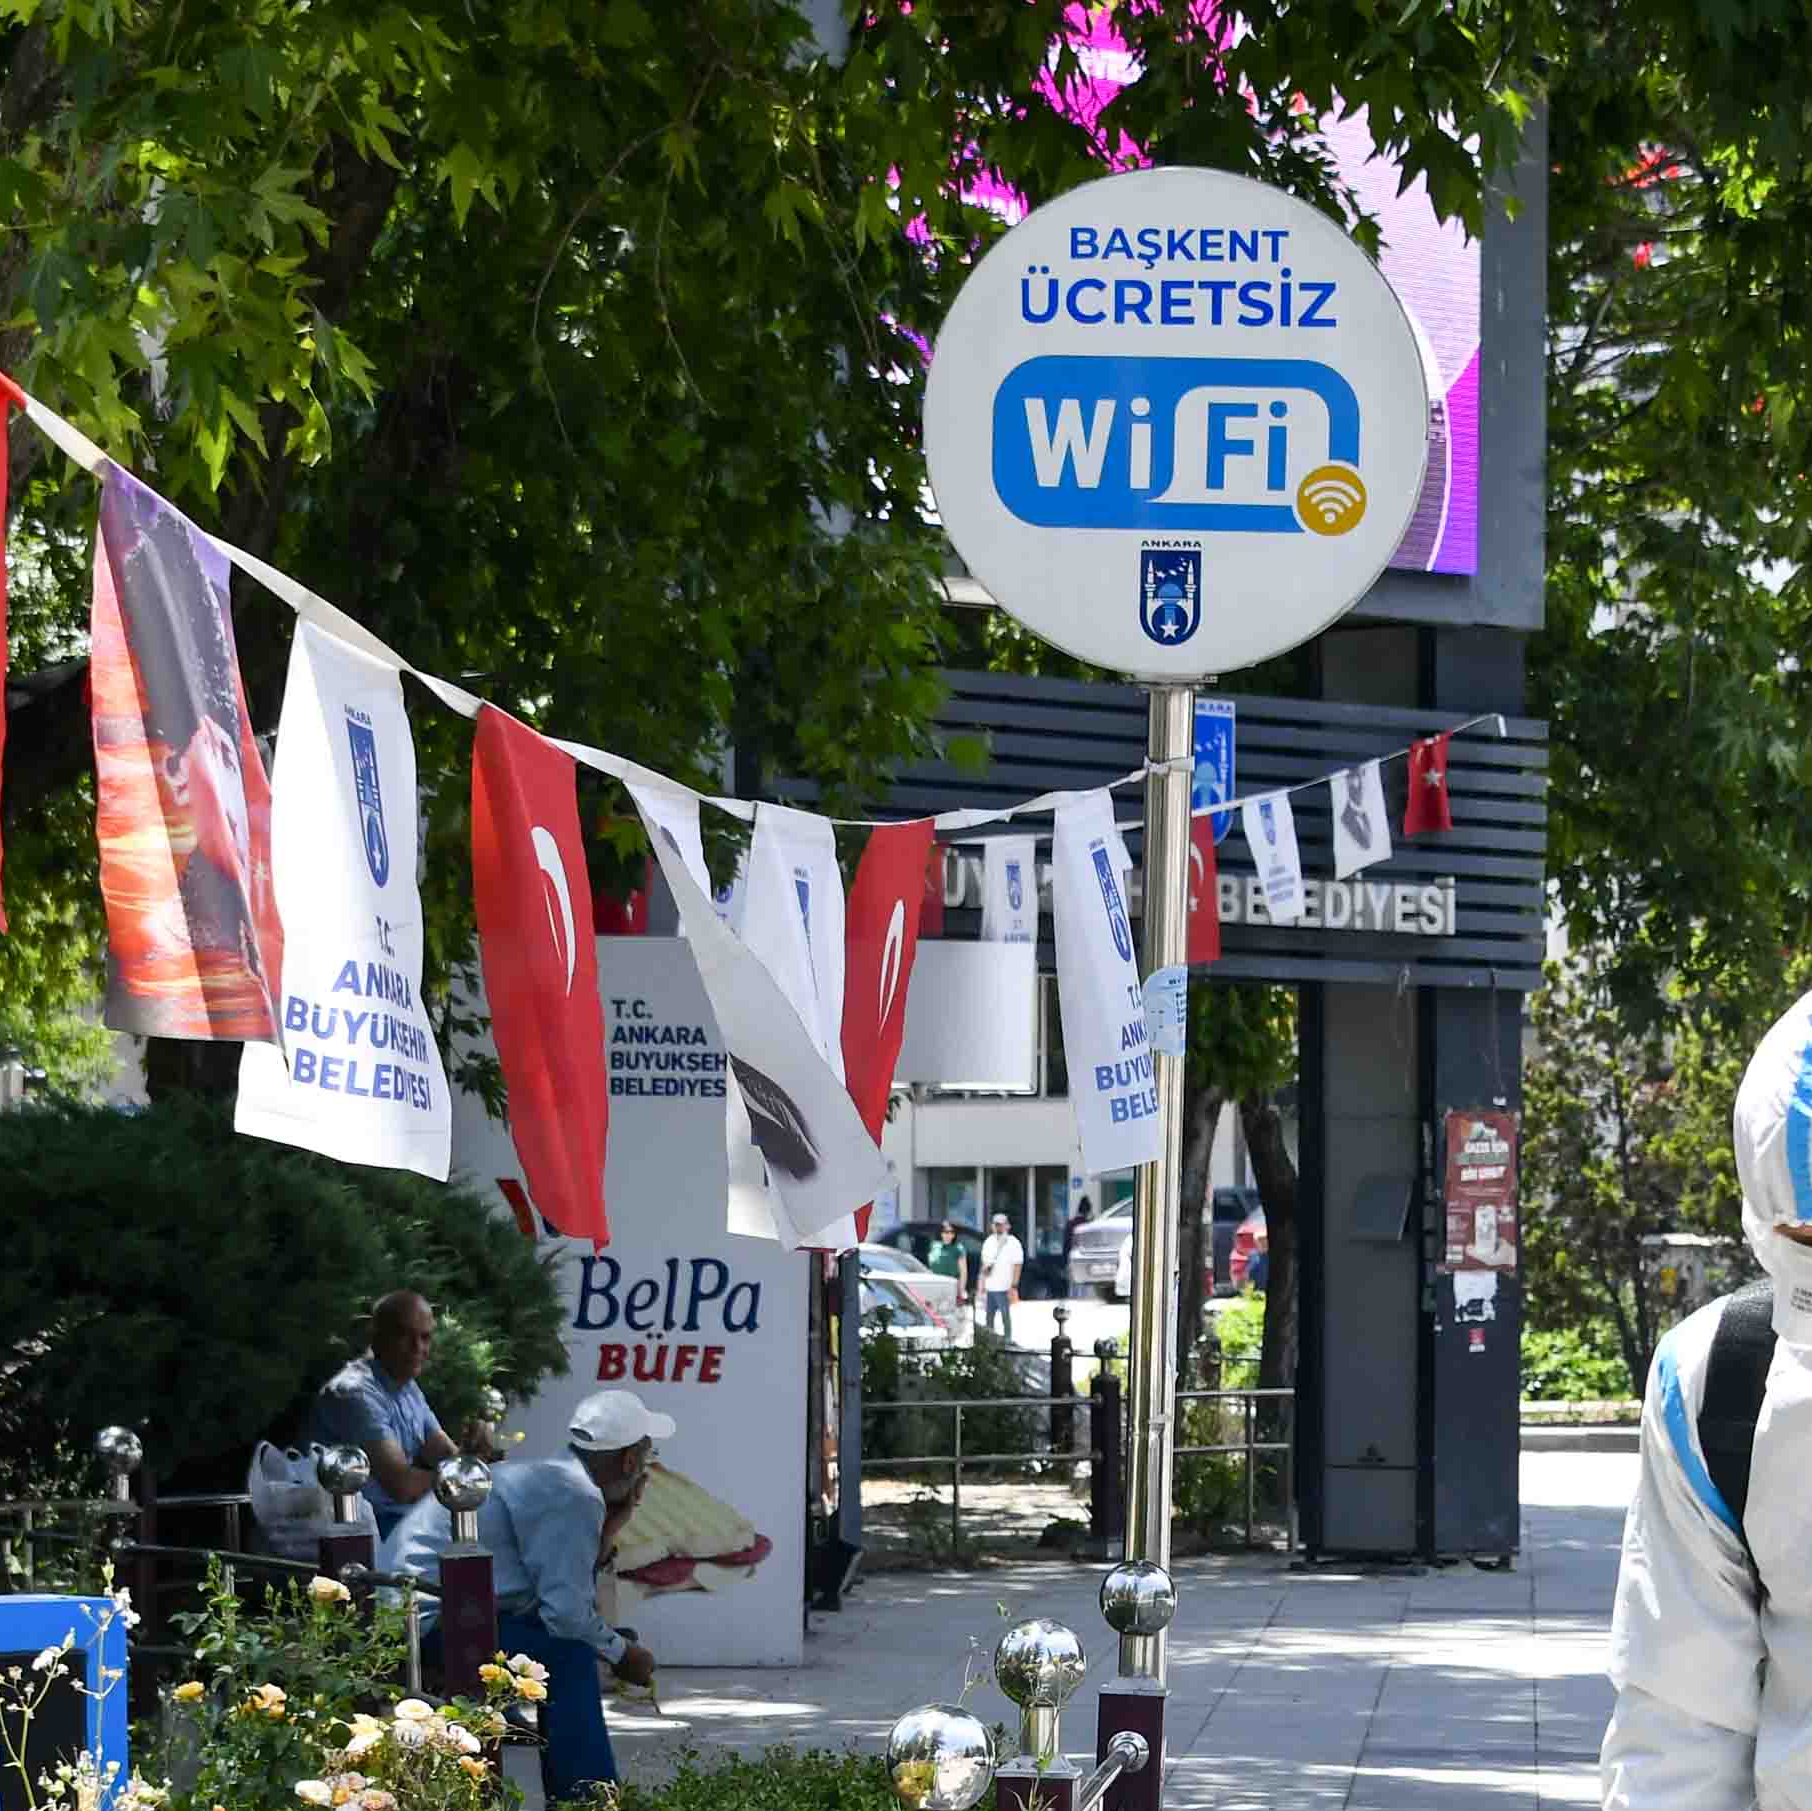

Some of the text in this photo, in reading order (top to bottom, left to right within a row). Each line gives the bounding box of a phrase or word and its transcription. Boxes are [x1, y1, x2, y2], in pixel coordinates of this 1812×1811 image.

[1069, 226, 1290, 270] BAŞKENT
[1020, 264, 1338, 328] ÜCRETSİZ
[1141, 539, 1202, 549] ANKARA
[1217, 872, 1456, 936] BEEDİYESİ
[610, 999, 654, 1020] T.C.
[612, 1025, 708, 1047] ANKARA
[572, 1254, 762, 1334] BelPa
[595, 1331, 727, 1384] BÜFE
